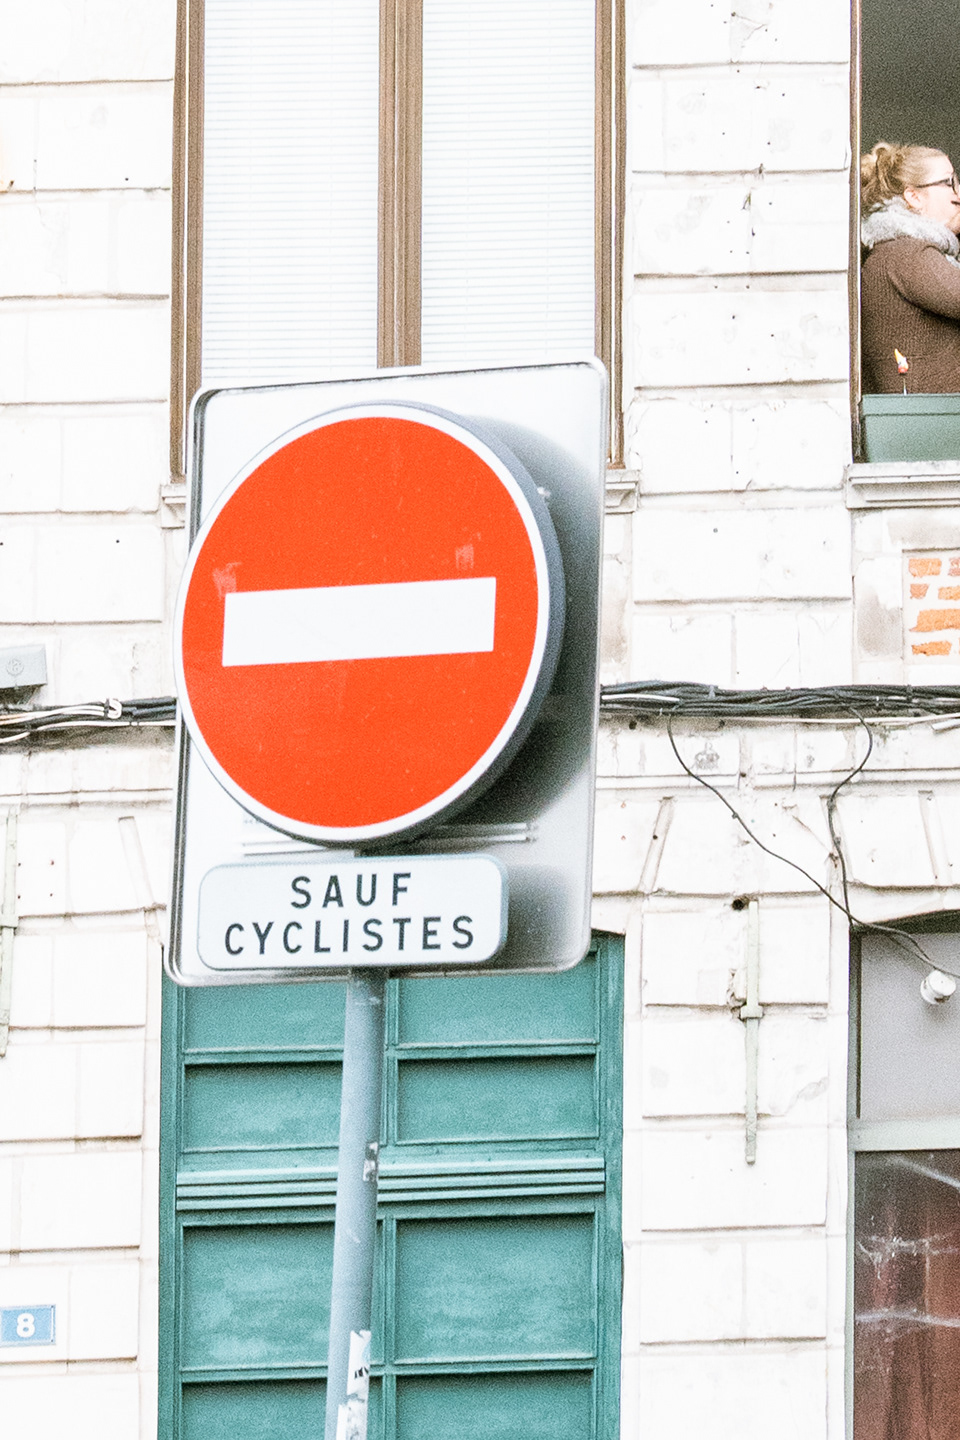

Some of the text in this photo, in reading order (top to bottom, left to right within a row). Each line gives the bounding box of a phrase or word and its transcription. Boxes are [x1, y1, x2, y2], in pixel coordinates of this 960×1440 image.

[290, 872, 412, 909] SAUF
[224, 915, 474, 956] CYCLISTES
[16, 1312, 36, 1338] 8
